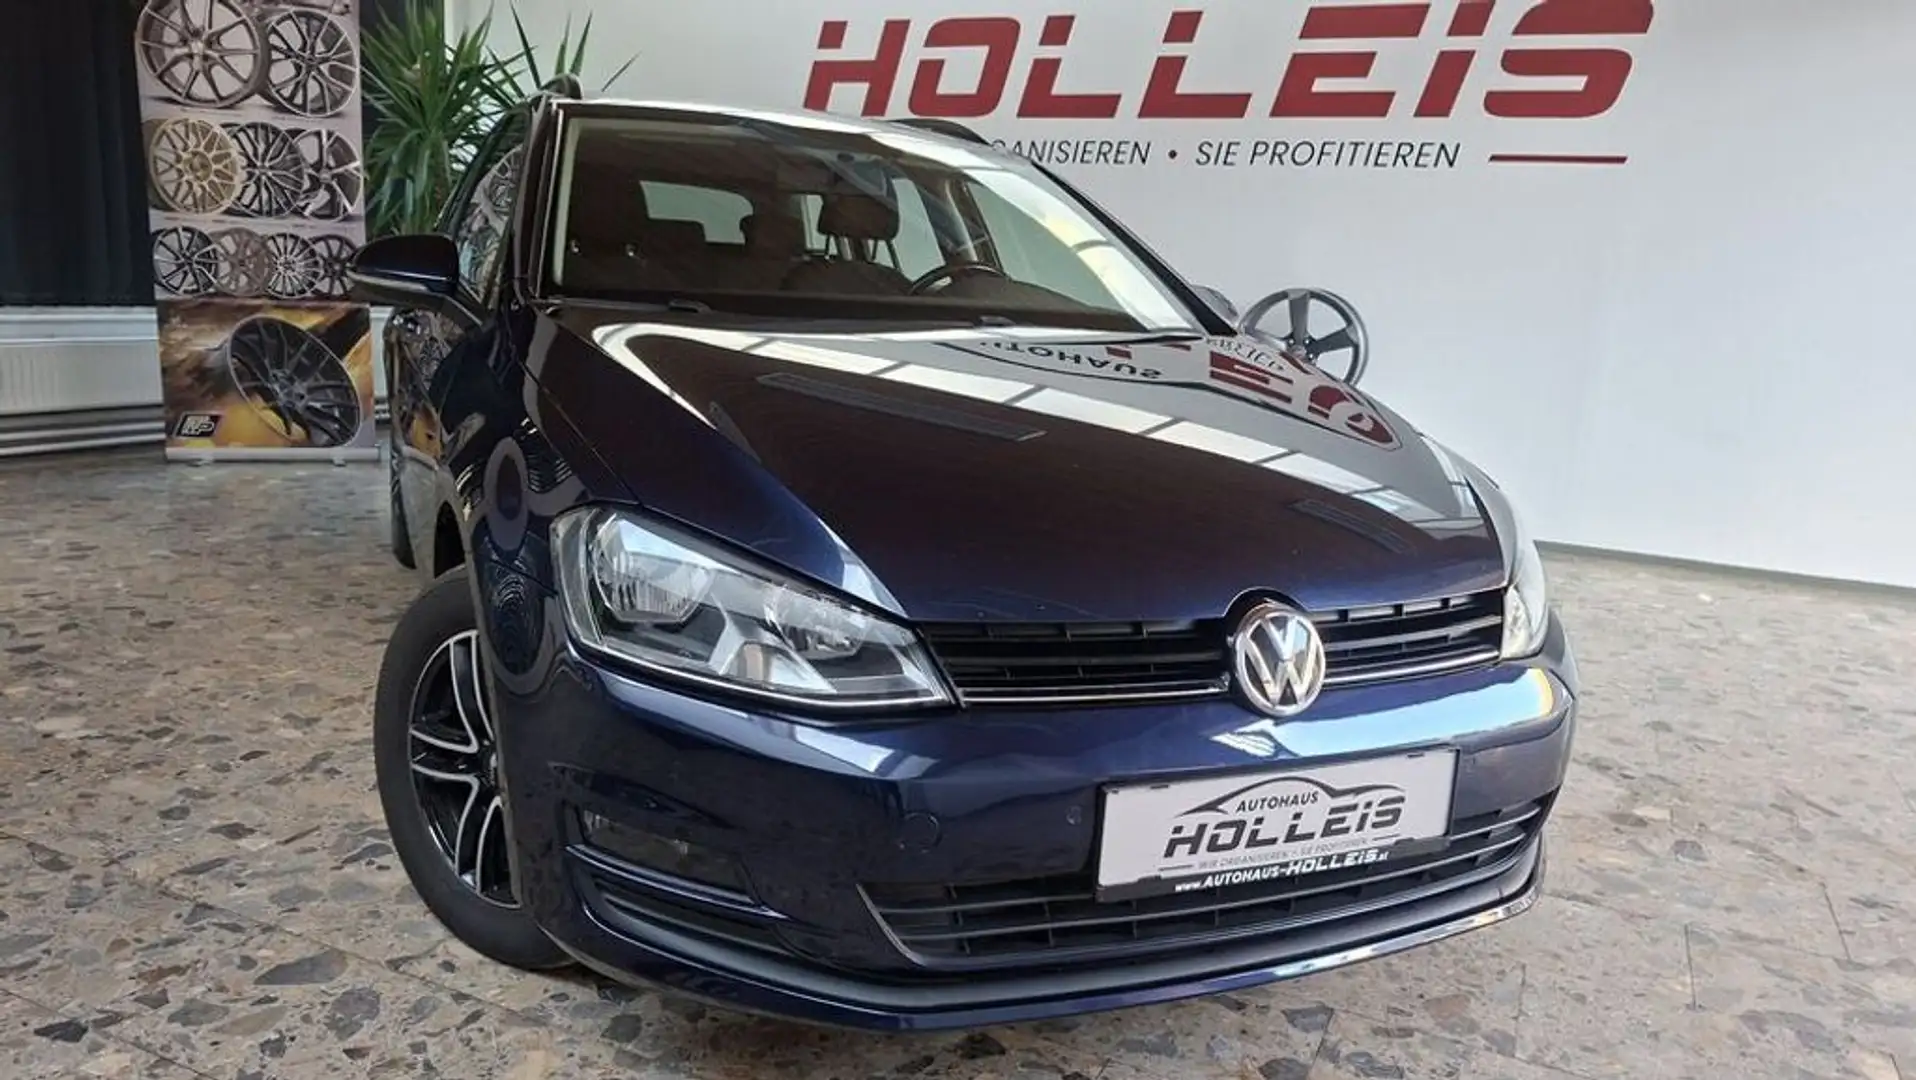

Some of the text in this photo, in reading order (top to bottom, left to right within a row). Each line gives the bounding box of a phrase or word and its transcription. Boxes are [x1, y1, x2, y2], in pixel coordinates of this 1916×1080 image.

[803, 0, 1653, 118] HOLLEIS
[1195, 140, 1241, 166] SIE
[1249, 140, 1461, 168] PROFITIEREN
[1236, 790, 1319, 813] AUTOHAUS
[1163, 795, 1407, 858] HOLLEIS
